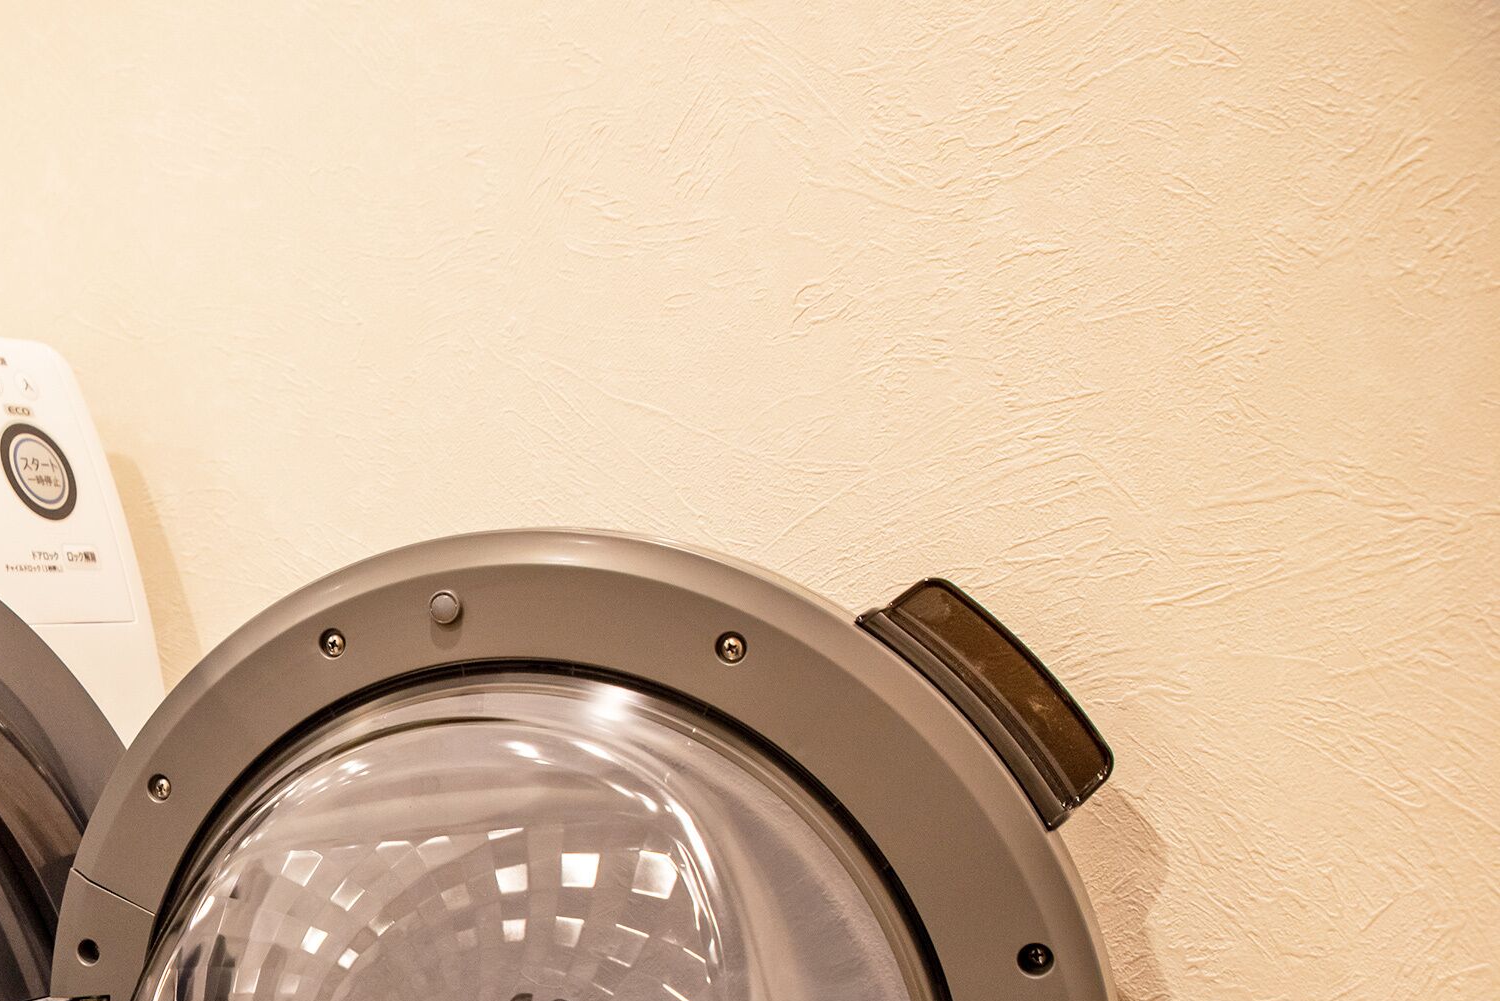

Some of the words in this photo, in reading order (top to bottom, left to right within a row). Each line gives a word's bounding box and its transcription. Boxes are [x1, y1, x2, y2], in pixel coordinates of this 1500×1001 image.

[7, 405, 31, 416] ECO
[20, 456, 59, 472] スタート
[27, 474, 61, 488] 一時停止
[31, 551, 59, 561] ドアロック
